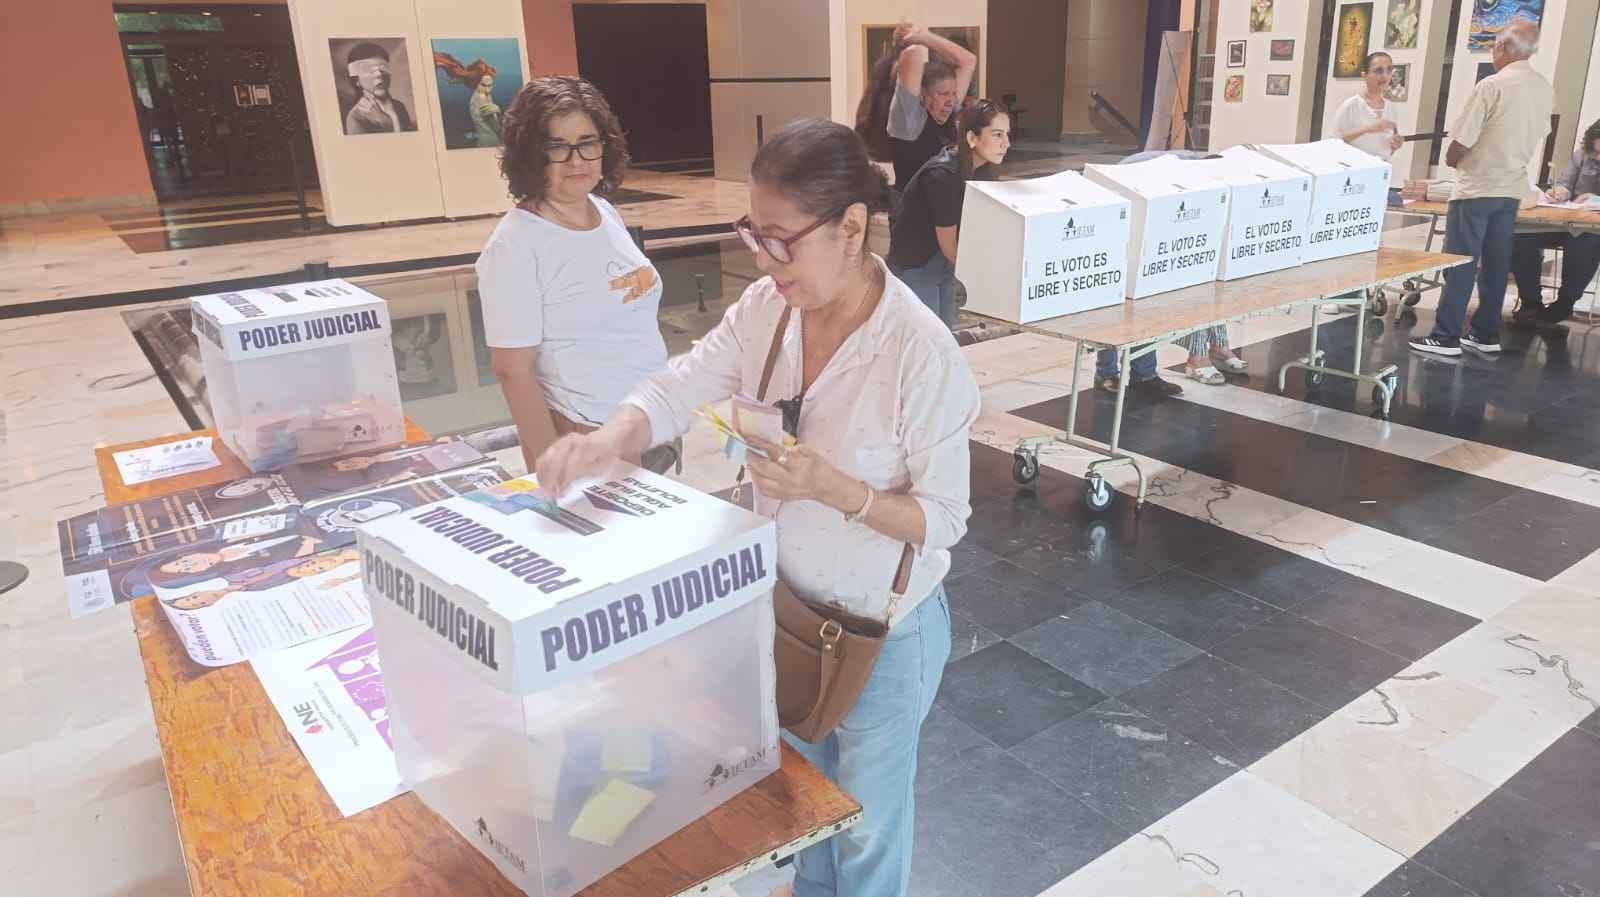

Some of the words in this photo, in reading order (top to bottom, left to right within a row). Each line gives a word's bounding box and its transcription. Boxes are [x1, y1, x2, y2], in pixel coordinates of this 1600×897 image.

[1245, 226, 1256, 239] EL
[1258, 222, 1280, 237] VOTO
[1281, 219, 1292, 233] ES
[1325, 213, 1335, 225] EL
[1338, 208, 1359, 223] VOTO
[1360, 207, 1371, 219] ES
[1158, 241, 1169, 255] EL
[1171, 236, 1194, 252] VOTO
[1195, 233, 1207, 247] ES
[1309, 229, 1334, 244] LIBRE
[1336, 227, 1343, 239] Y
[1342, 221, 1379, 239] SECRETO
[1231, 243, 1256, 260] LIBRE
[1258, 241, 1264, 254] Y
[1264, 235, 1302, 253] SECRETO
[1045, 261, 1059, 276] EL
[1061, 255, 1091, 273] VOTO
[1093, 252, 1107, 267] ES
[1142, 259, 1168, 277] LIBRE
[1170, 257, 1176, 271] Y
[1176, 249, 1216, 269] SECRETO
[1028, 281, 1060, 300] LIBRE
[1063, 279, 1070, 293] Y
[1072, 269, 1121, 292] SECRETO
[239, 324, 301, 351] PODER
[303, 309, 381, 341] JUDICIAL
[586, 485, 657, 516] DEPOSITE
[622, 477, 688, 504] BOLETAS
[409, 506, 515, 555] JUDICIAL
[487, 544, 582, 594] PODER
[364, 548, 415, 615] PODER
[418, 582, 498, 672] JUDICIAL
[540, 591, 649, 672] PODER
[654, 543, 767, 626] JUDICIAL
